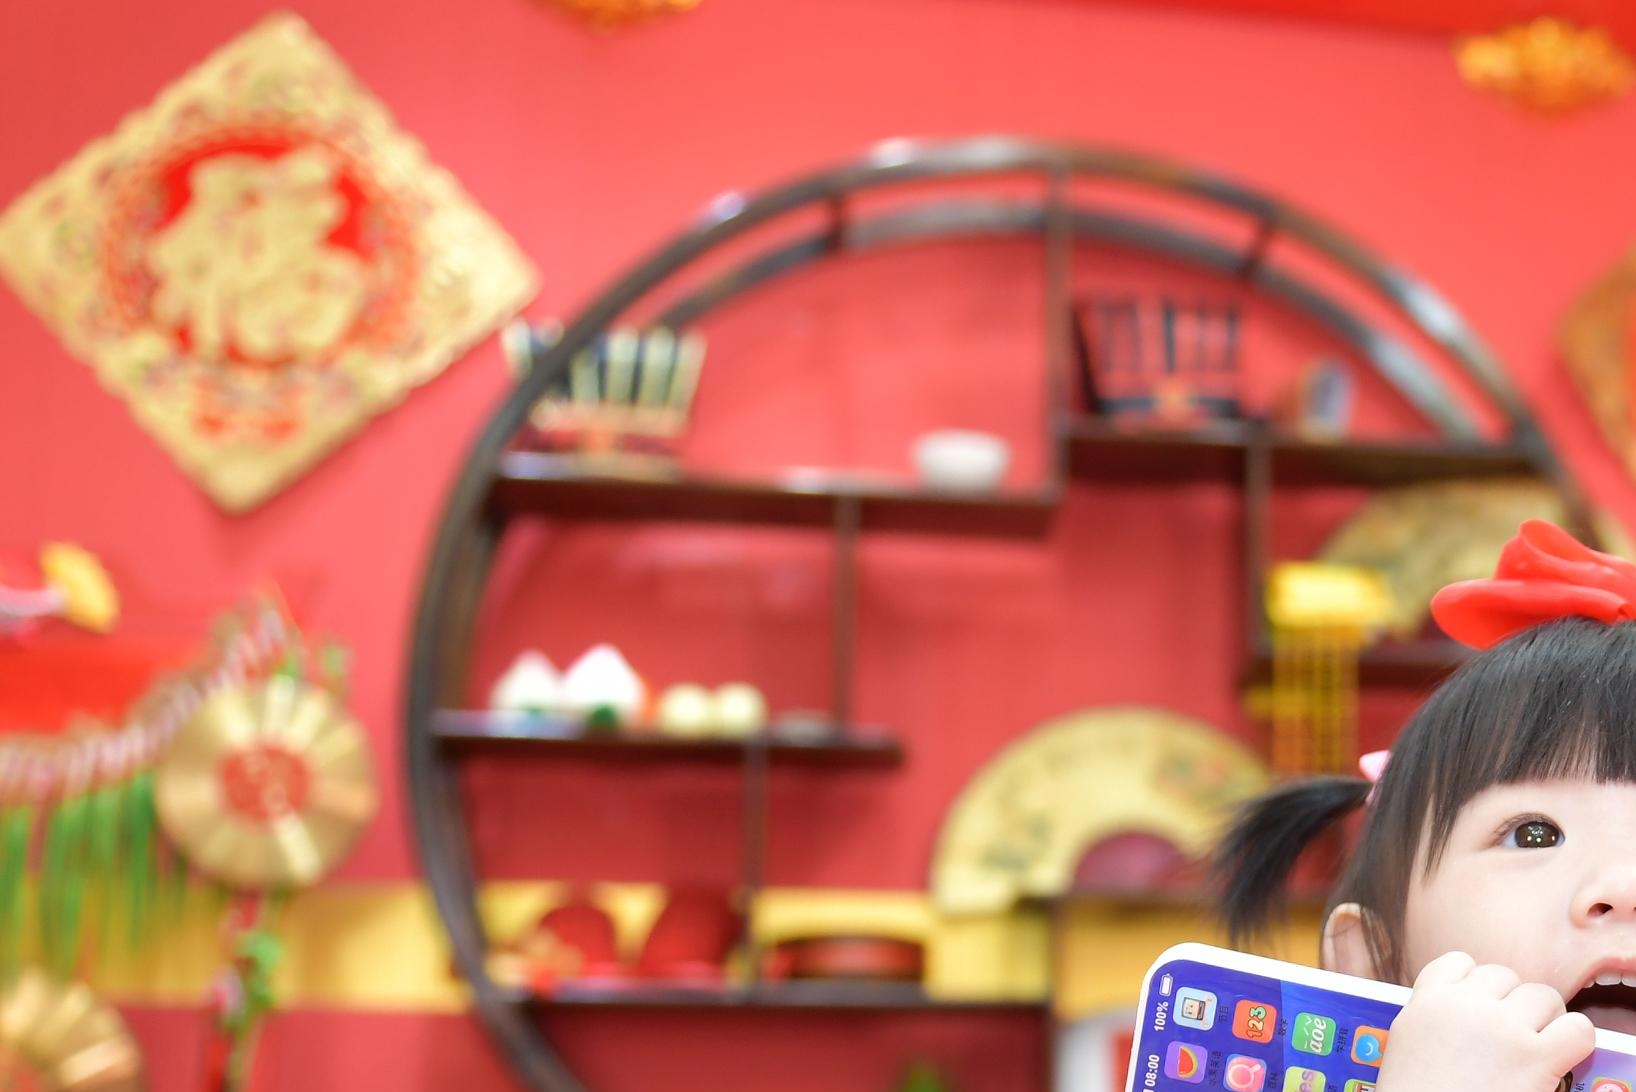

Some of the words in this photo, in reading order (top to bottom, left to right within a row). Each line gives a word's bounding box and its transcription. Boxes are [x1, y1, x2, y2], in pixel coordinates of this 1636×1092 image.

[1153, 1000, 1169, 1032] 100%
[1245, 1004, 1267, 1039] 123
[1144, 1054, 1160, 1087] 08:00
